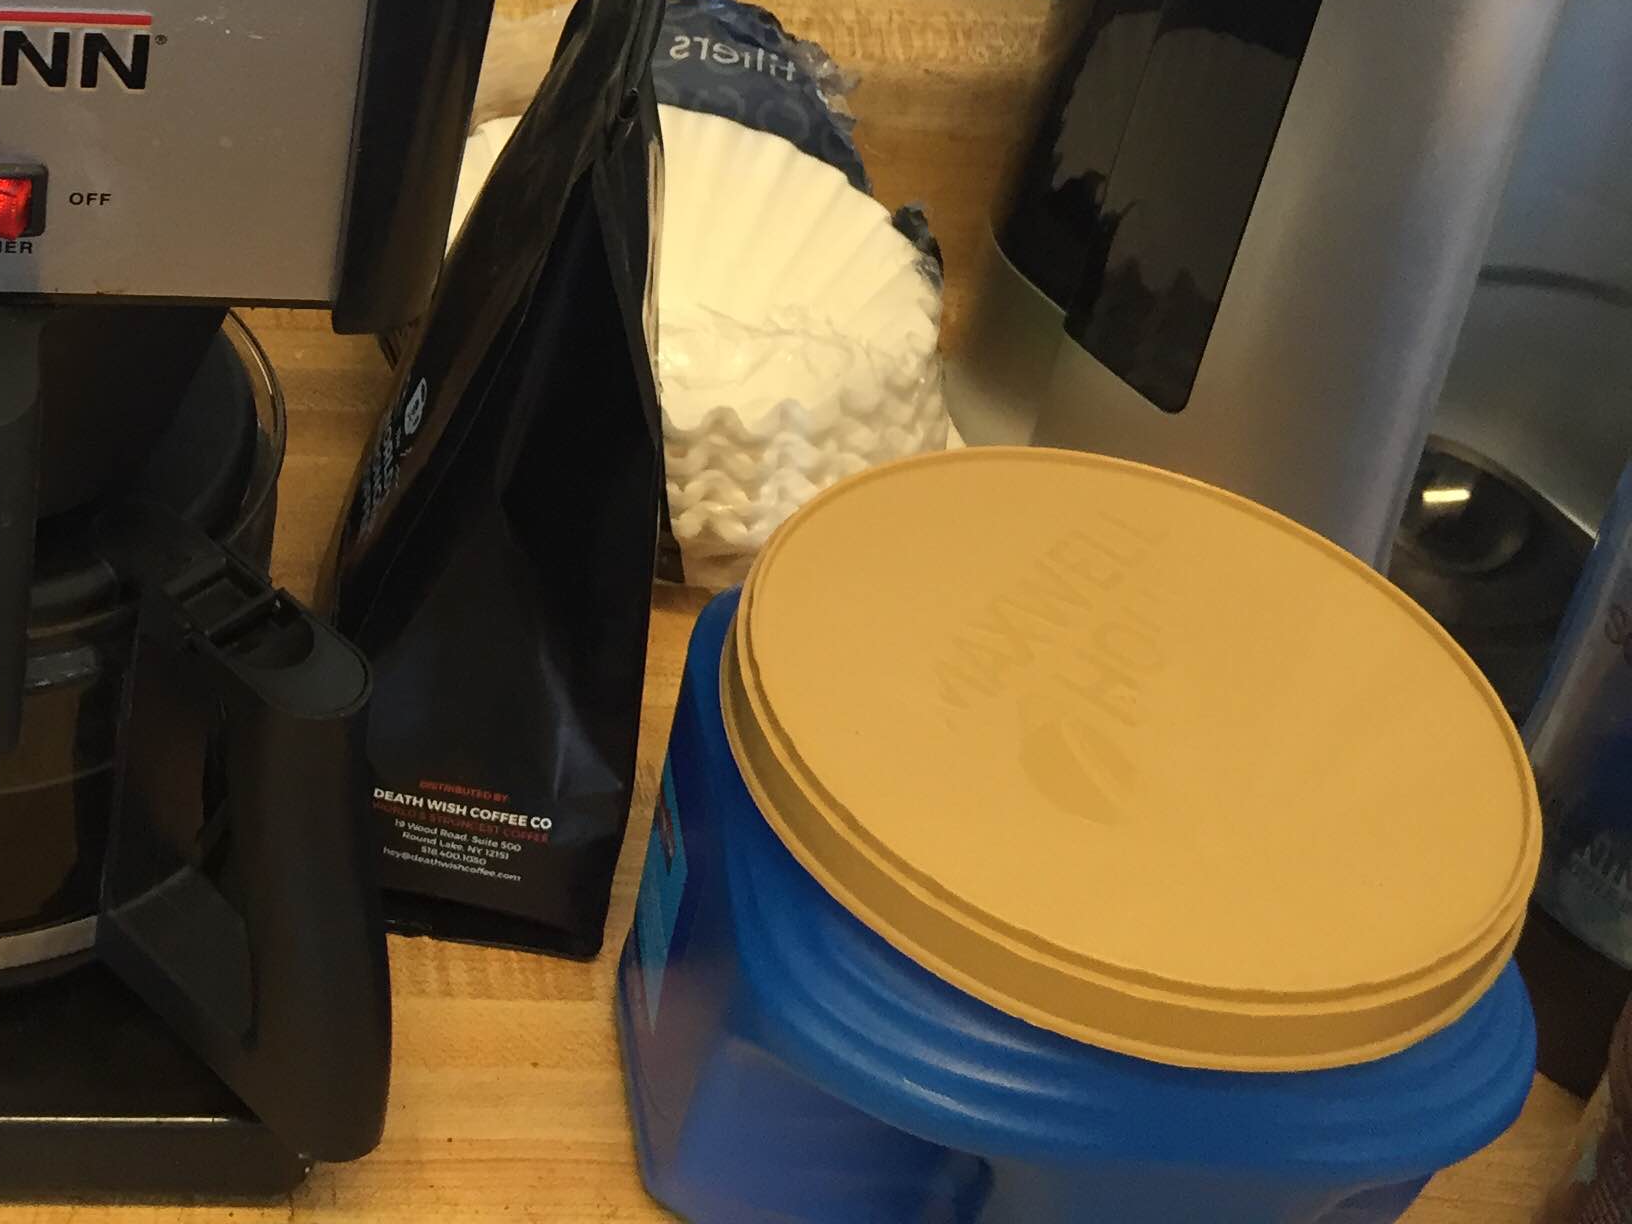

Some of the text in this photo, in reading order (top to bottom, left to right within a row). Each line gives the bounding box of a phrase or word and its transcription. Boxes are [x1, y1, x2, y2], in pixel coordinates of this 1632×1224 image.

[69, 192, 112, 206] OFF
[373, 787, 553, 830] DEATH WISH COFFEE CO
